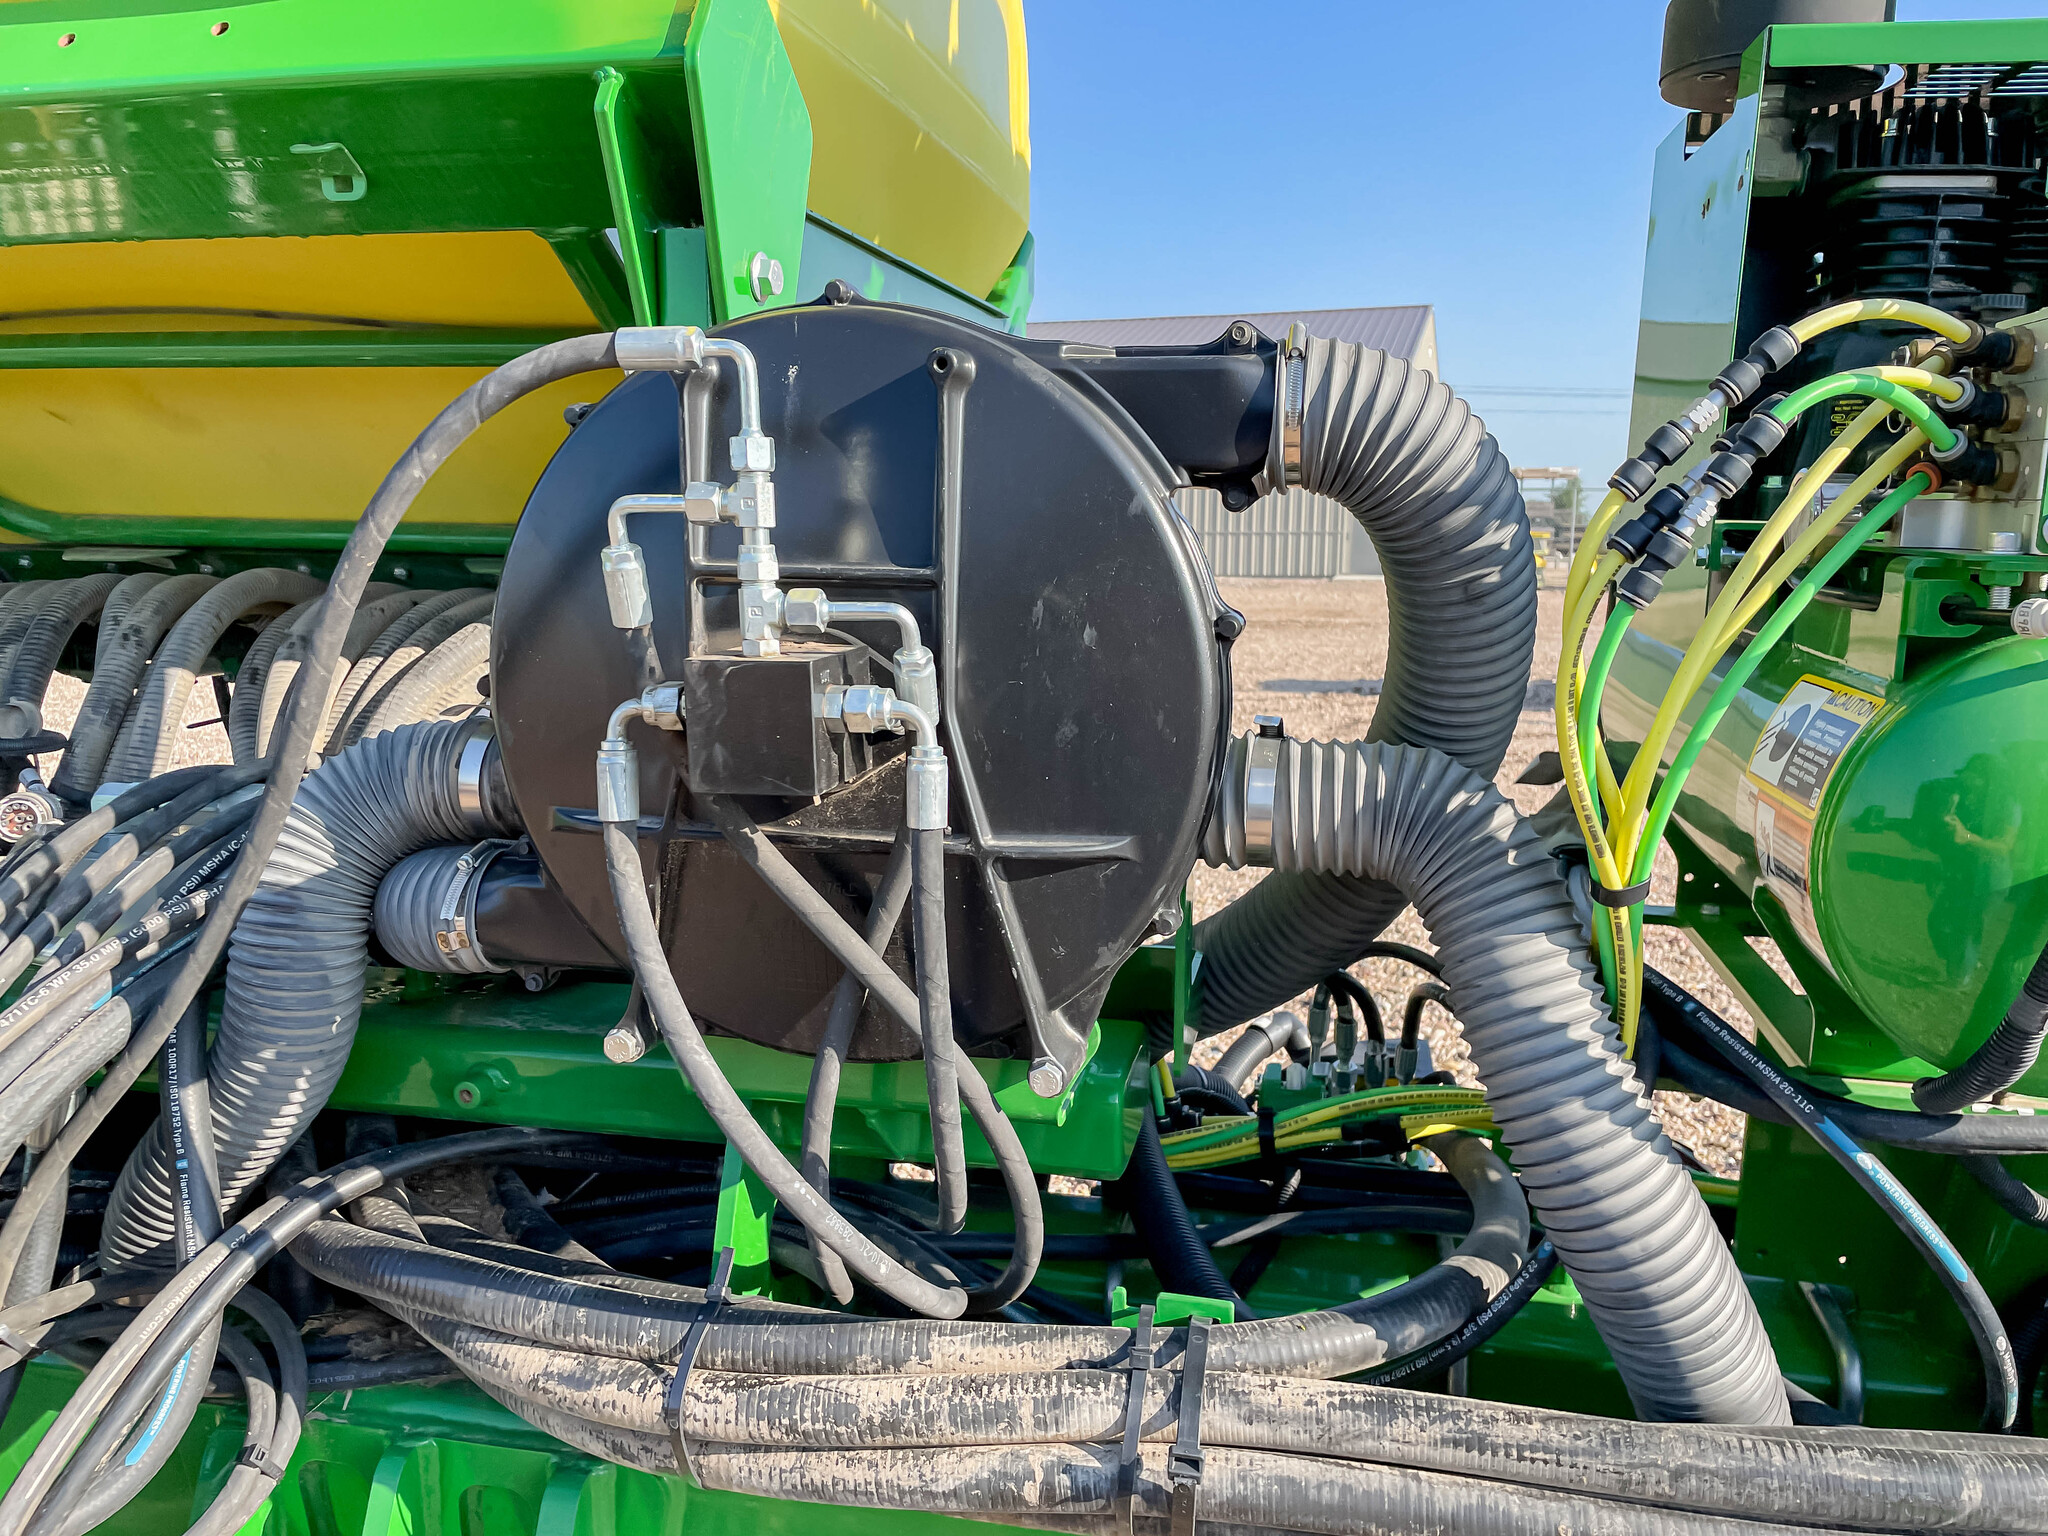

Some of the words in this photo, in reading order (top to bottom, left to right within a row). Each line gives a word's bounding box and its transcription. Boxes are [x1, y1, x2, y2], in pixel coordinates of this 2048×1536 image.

[1833, 691, 1881, 719] CAUTION
[179, 874, 202, 896] PSI)
[199, 850, 231, 878] MSHA
[46, 969, 77, 991] WP
[100, 937, 130, 957] MPa
[164, 900, 191, 919] PSI)
[1696, 1011, 1720, 1033] Flame
[1718, 1029, 1758, 1065] Resistant
[1755, 1060, 1782, 1085] MSHA
[179, 1173, 190, 1199] Flame
[1875, 1172, 1910, 1211] POWERING
[183, 1199, 196, 1240] Resistant
[168, 1359, 187, 1396] POWERING
